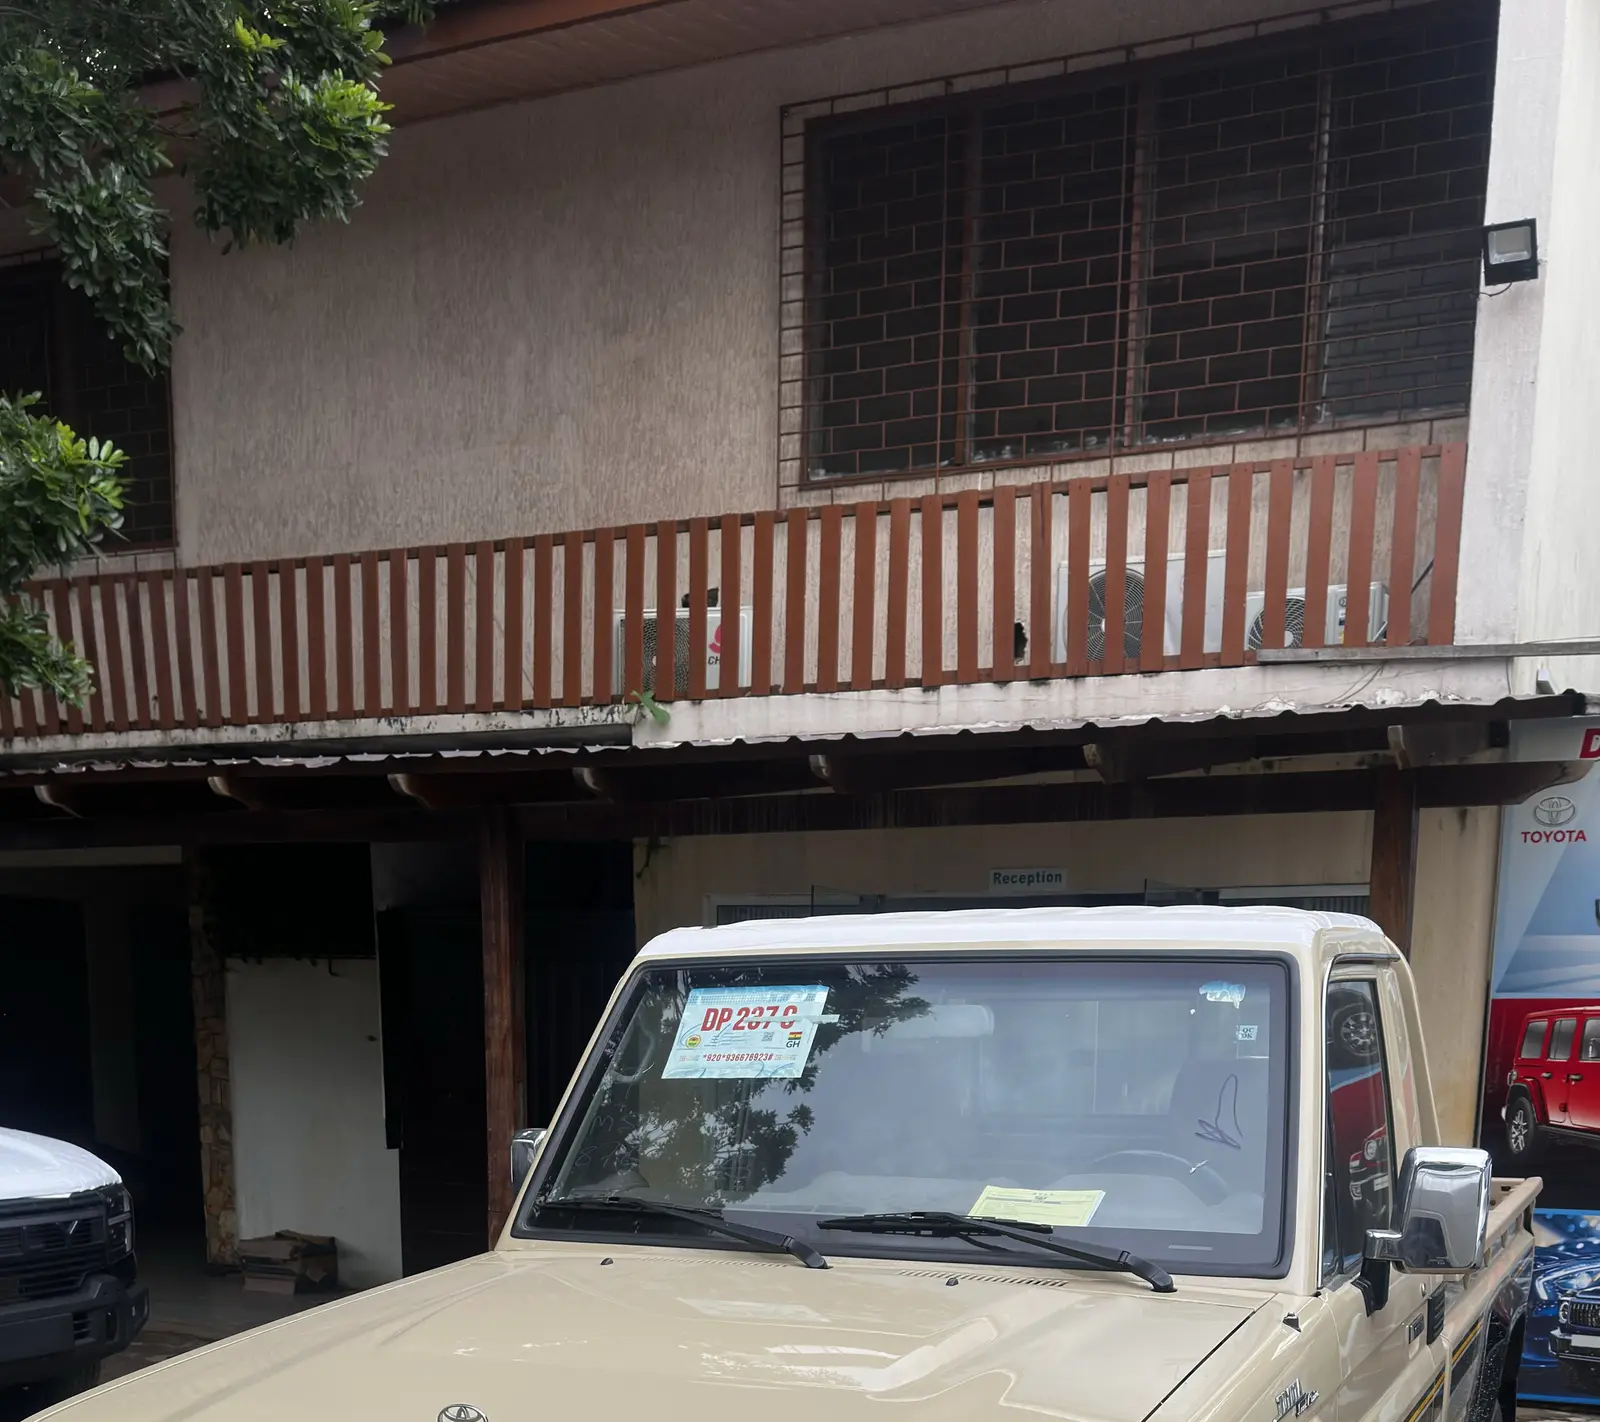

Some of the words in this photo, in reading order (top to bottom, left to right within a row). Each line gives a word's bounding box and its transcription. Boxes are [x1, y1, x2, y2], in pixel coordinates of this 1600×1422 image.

[1521, 830, 1587, 844] TOYOTA
[993, 871, 1062, 887] Reception
[701, 1007, 733, 1032] DP
[785, 1040, 800, 1049] GH
